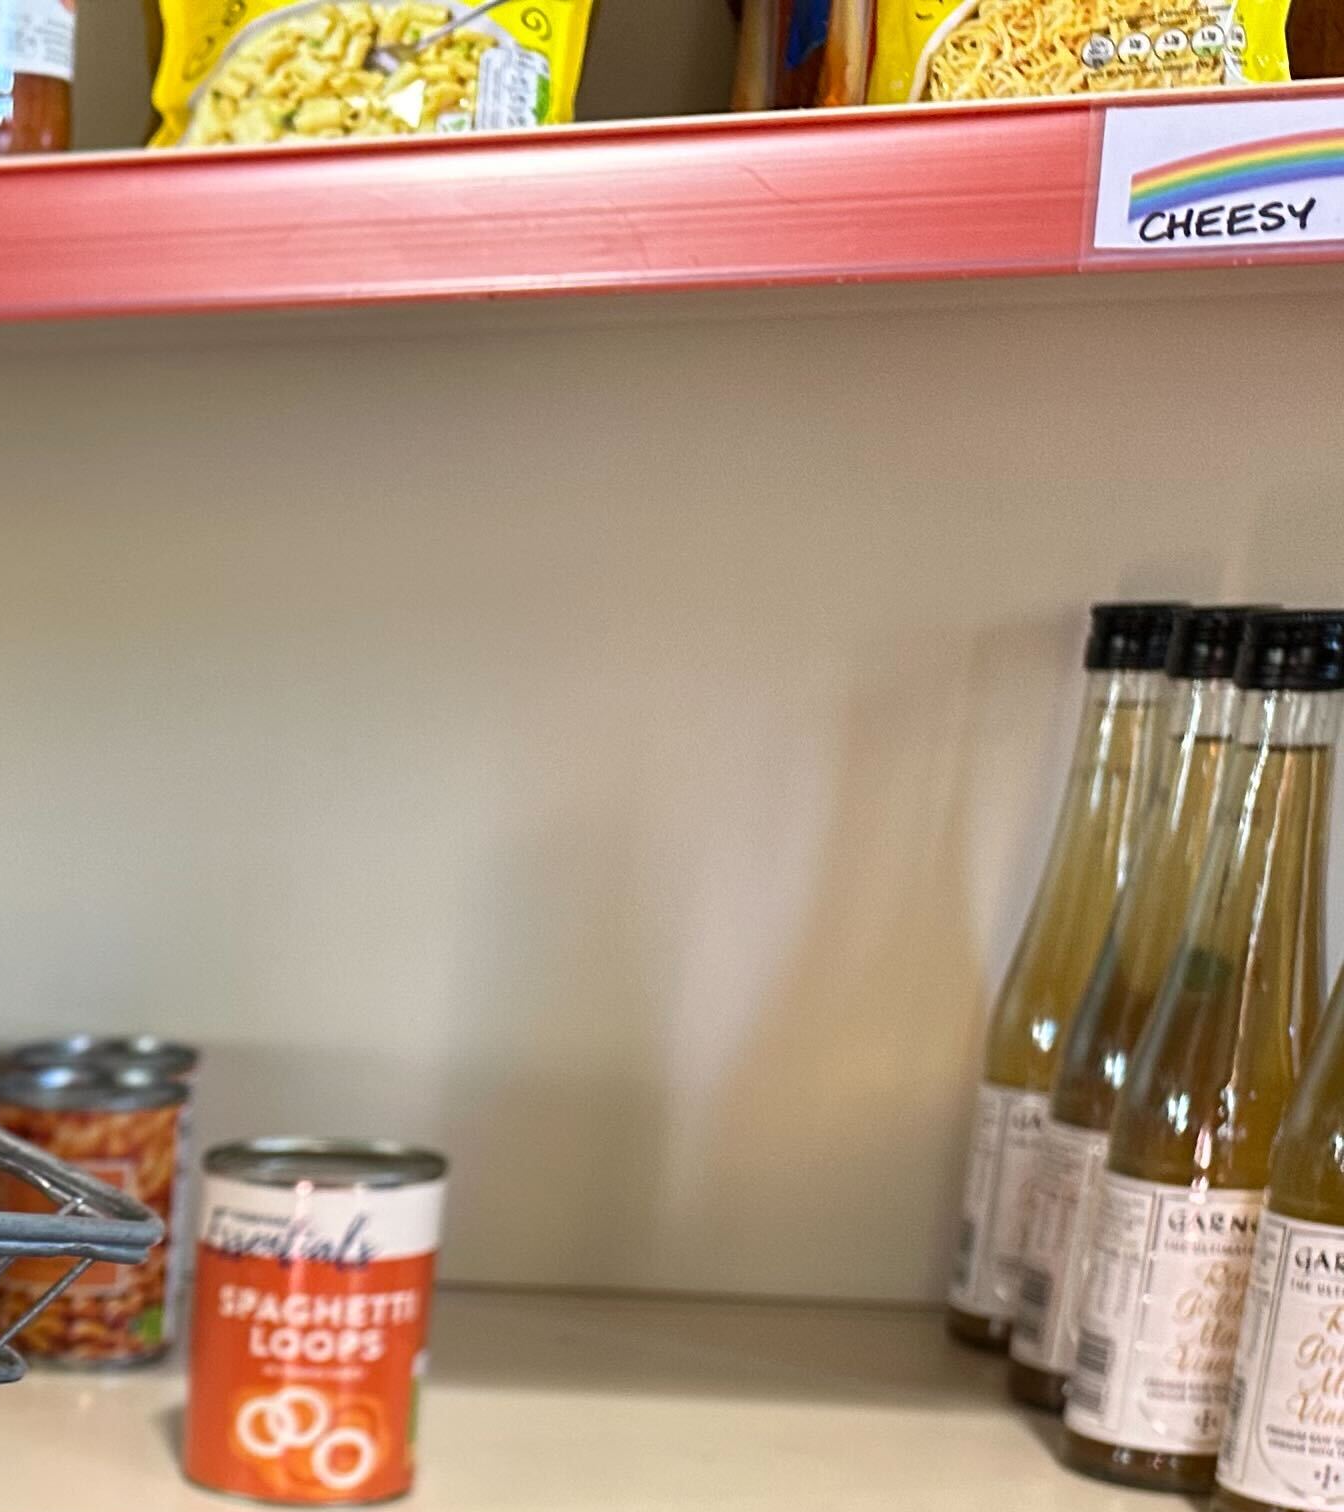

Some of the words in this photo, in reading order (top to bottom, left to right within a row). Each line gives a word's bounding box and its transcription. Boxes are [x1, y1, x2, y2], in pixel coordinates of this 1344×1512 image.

[1139, 197, 1316, 242] CHEESY
[1295, 1246, 1344, 1275] GAR
[218, 1284, 420, 1328] SPAGHETTI
[249, 1325, 385, 1363] LOOPS
